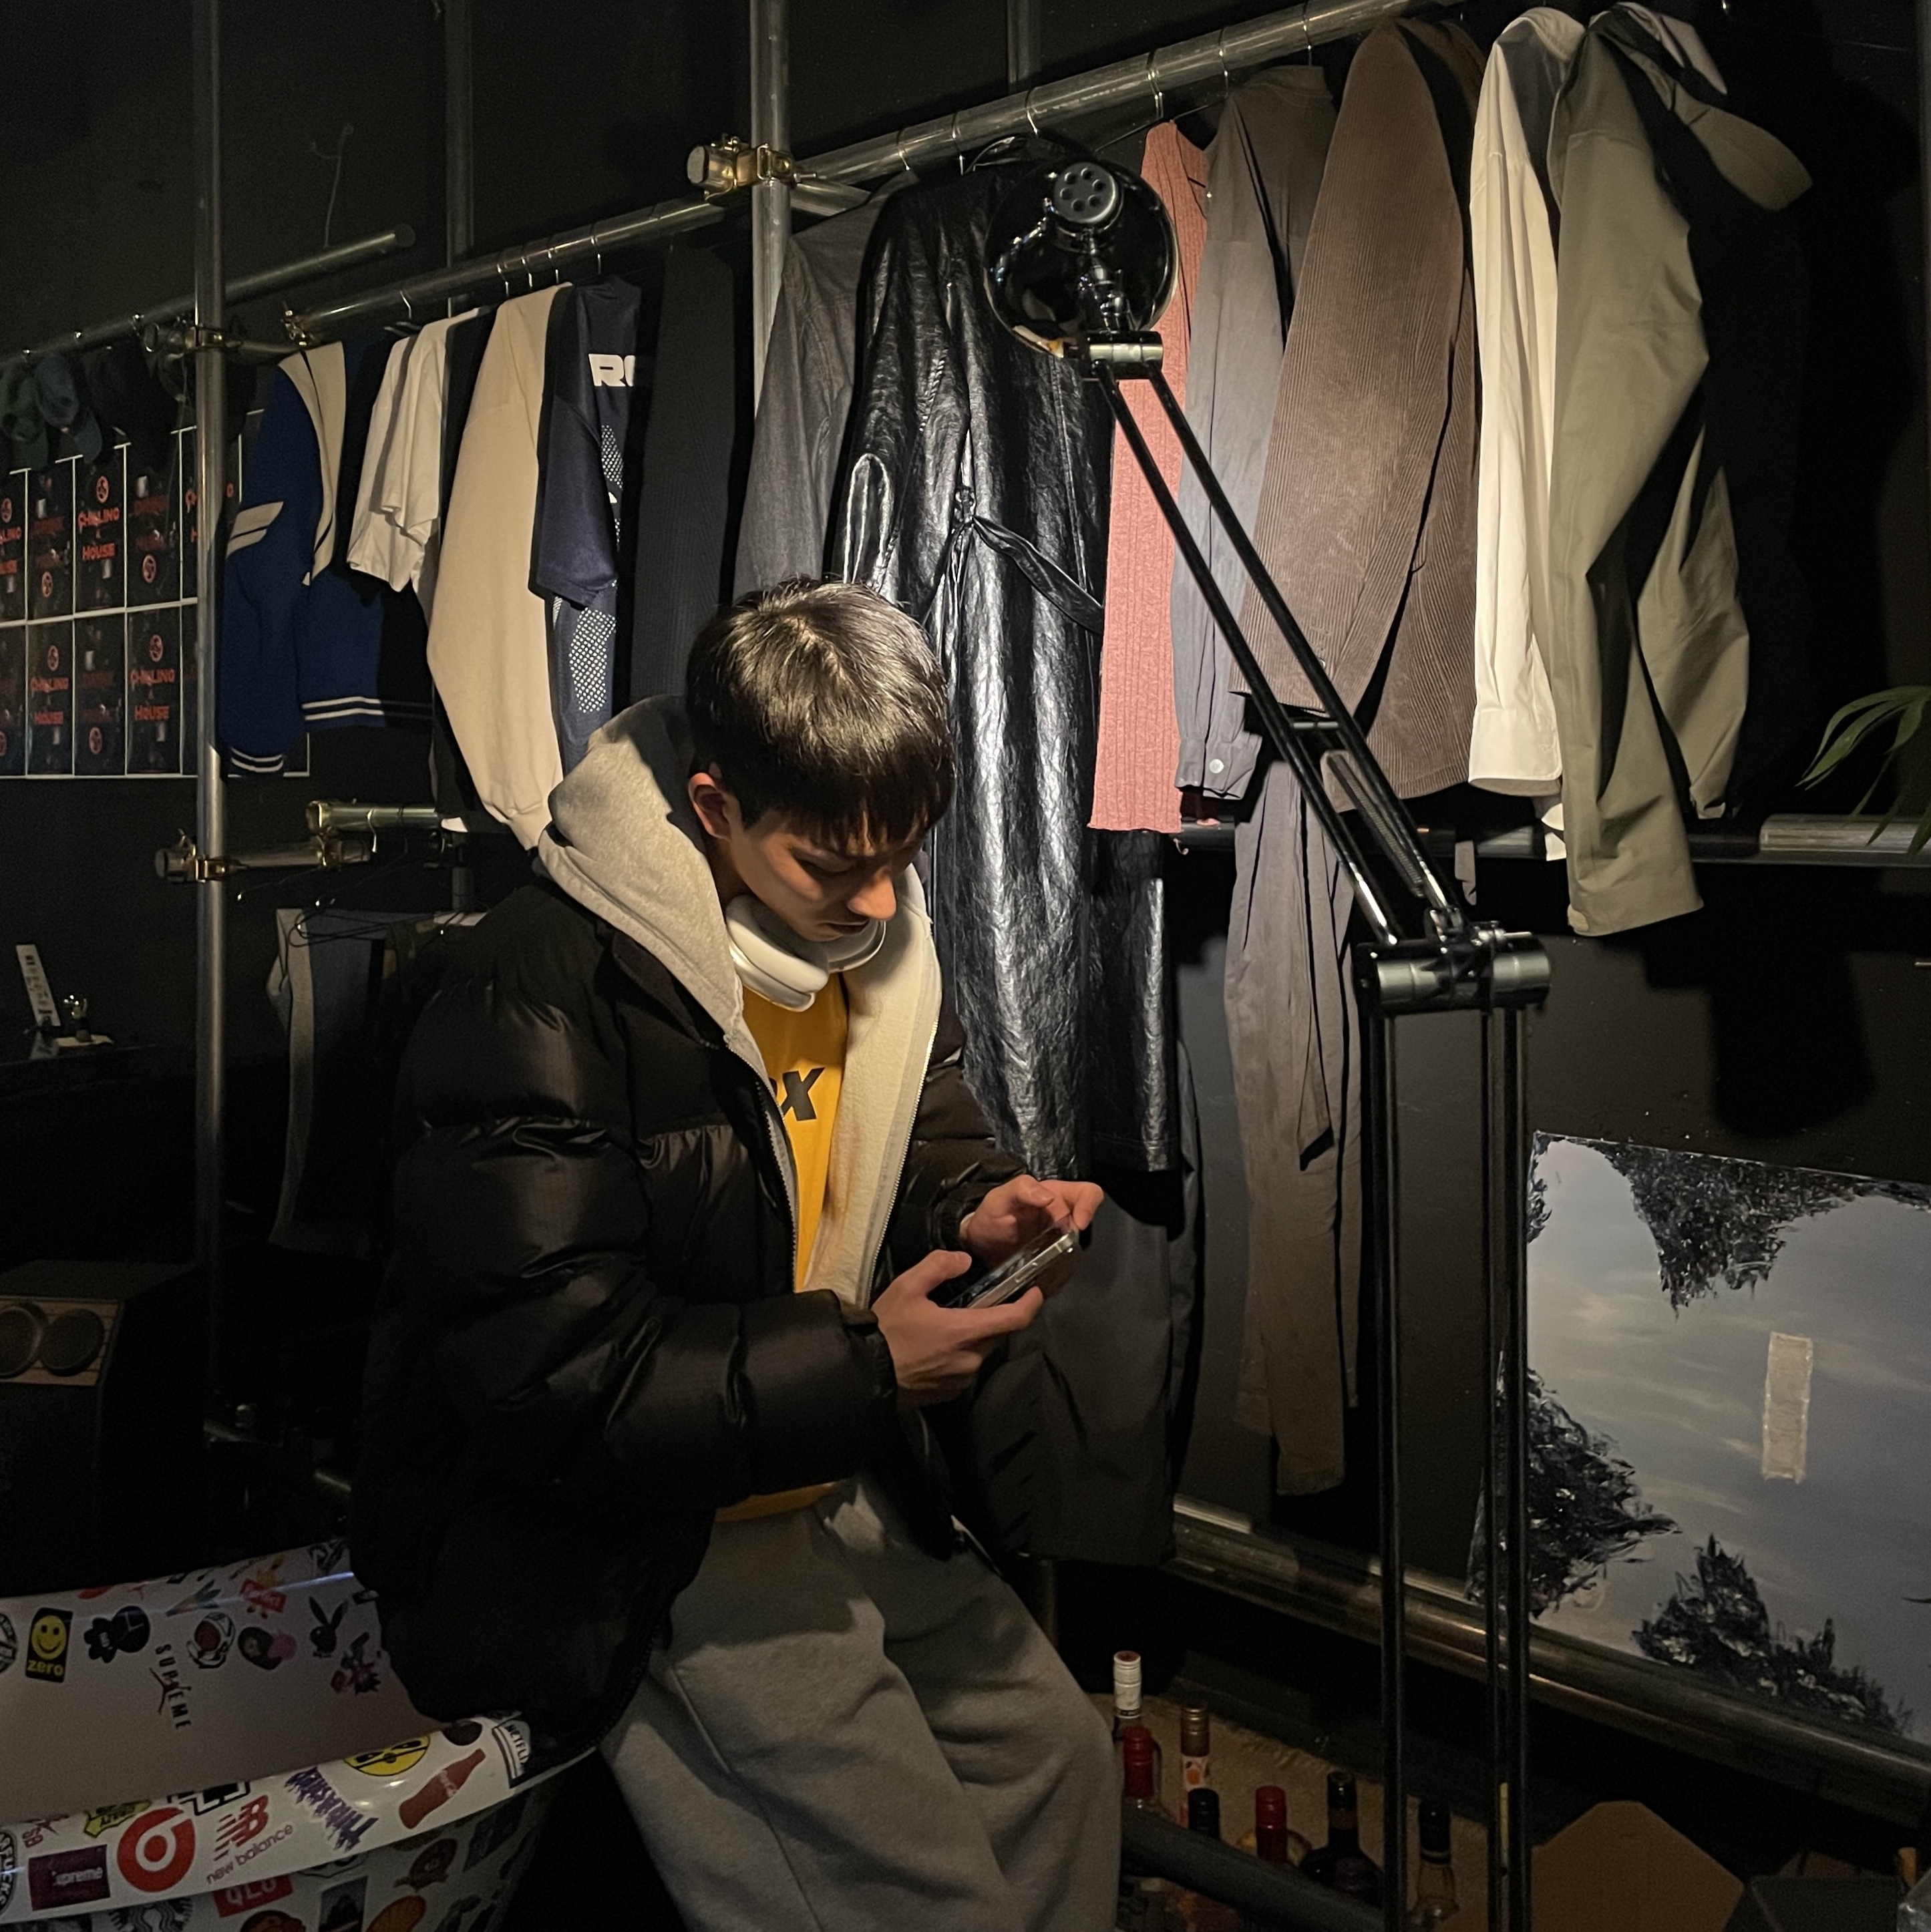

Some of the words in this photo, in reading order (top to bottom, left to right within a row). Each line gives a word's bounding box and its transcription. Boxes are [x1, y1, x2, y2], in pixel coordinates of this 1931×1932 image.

[81, 542, 116, 560] HOUSE
[134, 705, 170, 721] HOUSE
[769, 1067, 826, 1121] X
[27, 1660, 65, 1677] zero
[206, 1862, 235, 1885] new
[235, 1824, 294, 1866] balance
